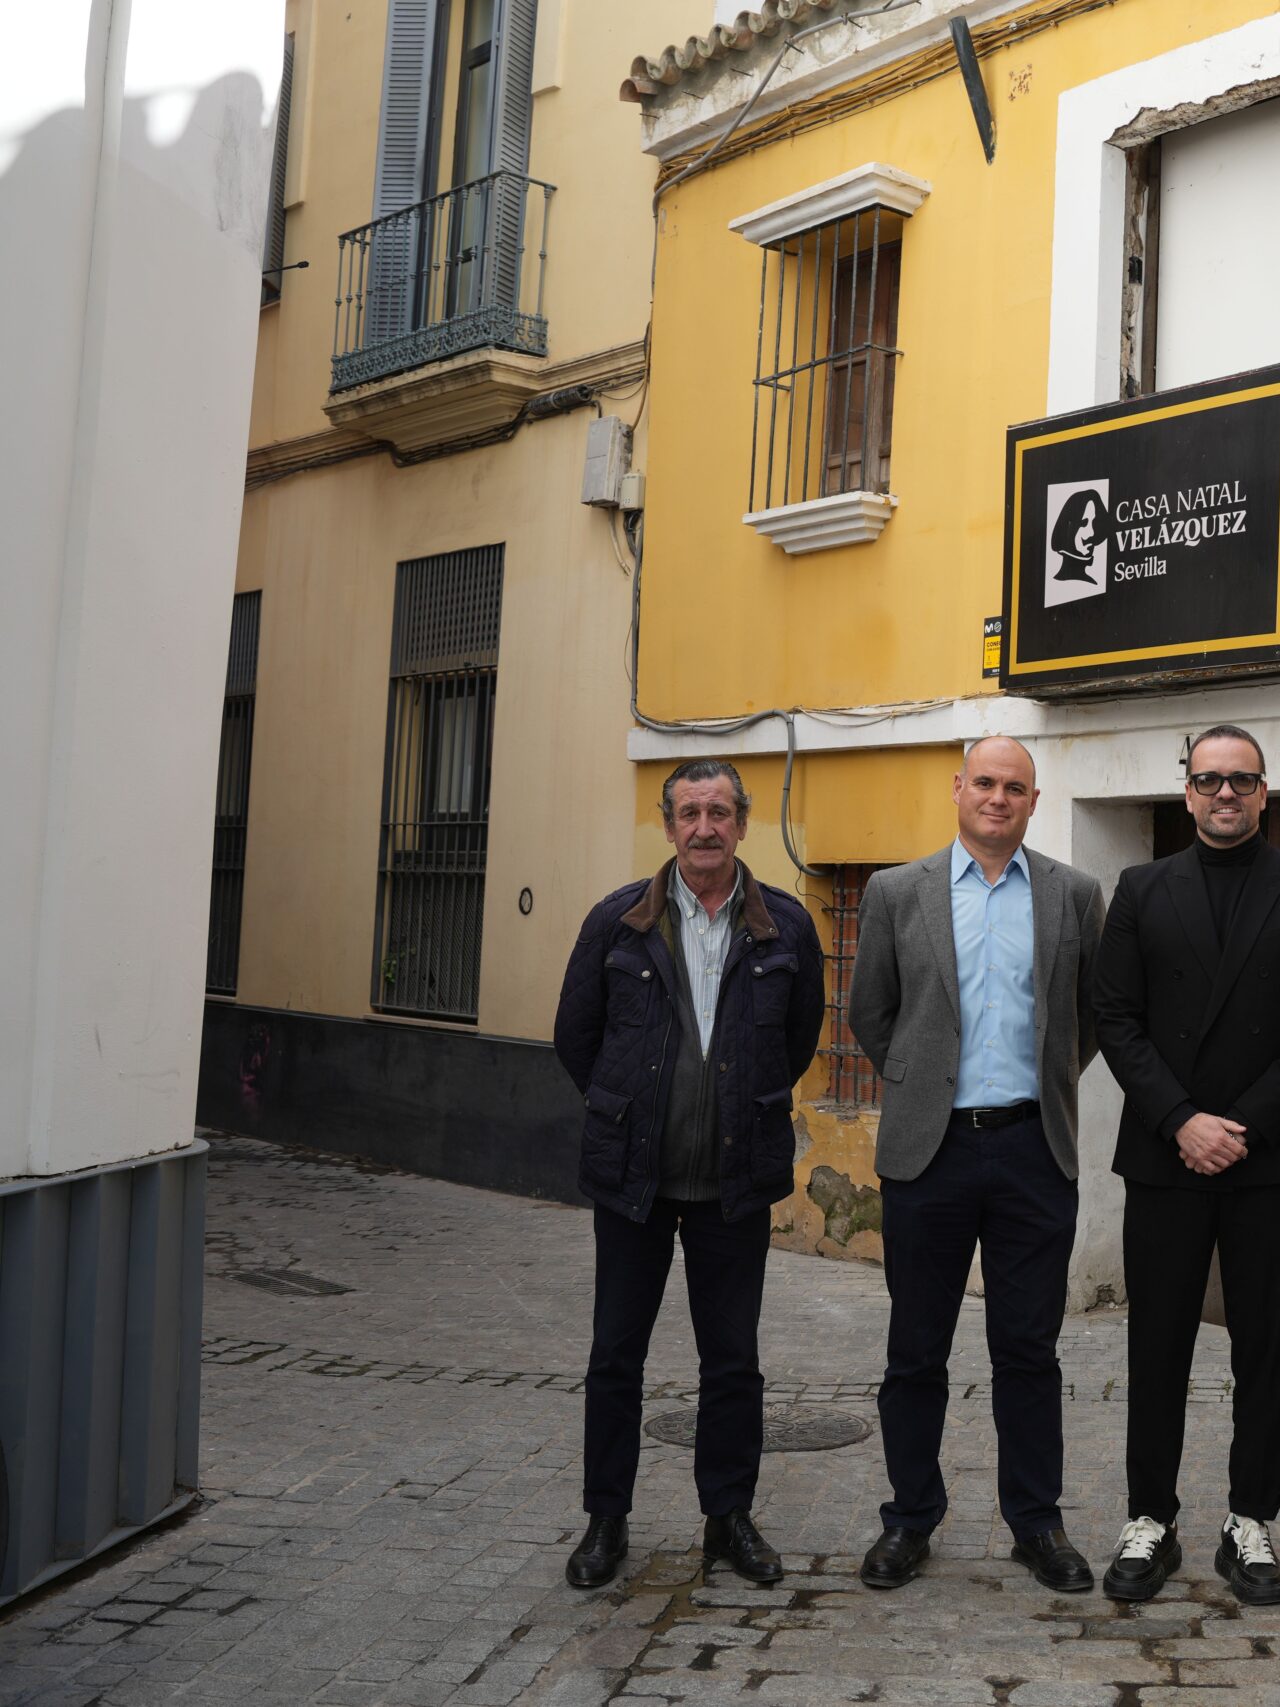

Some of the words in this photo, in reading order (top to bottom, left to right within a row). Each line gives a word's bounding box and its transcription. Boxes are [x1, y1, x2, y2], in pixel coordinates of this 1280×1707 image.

[1116, 494, 1170, 523] CASA
[1177, 480, 1247, 512] NATAL
[1116, 510, 1247, 552] VELÁZQUEZ
[1114, 556, 1167, 582] Sevilla
